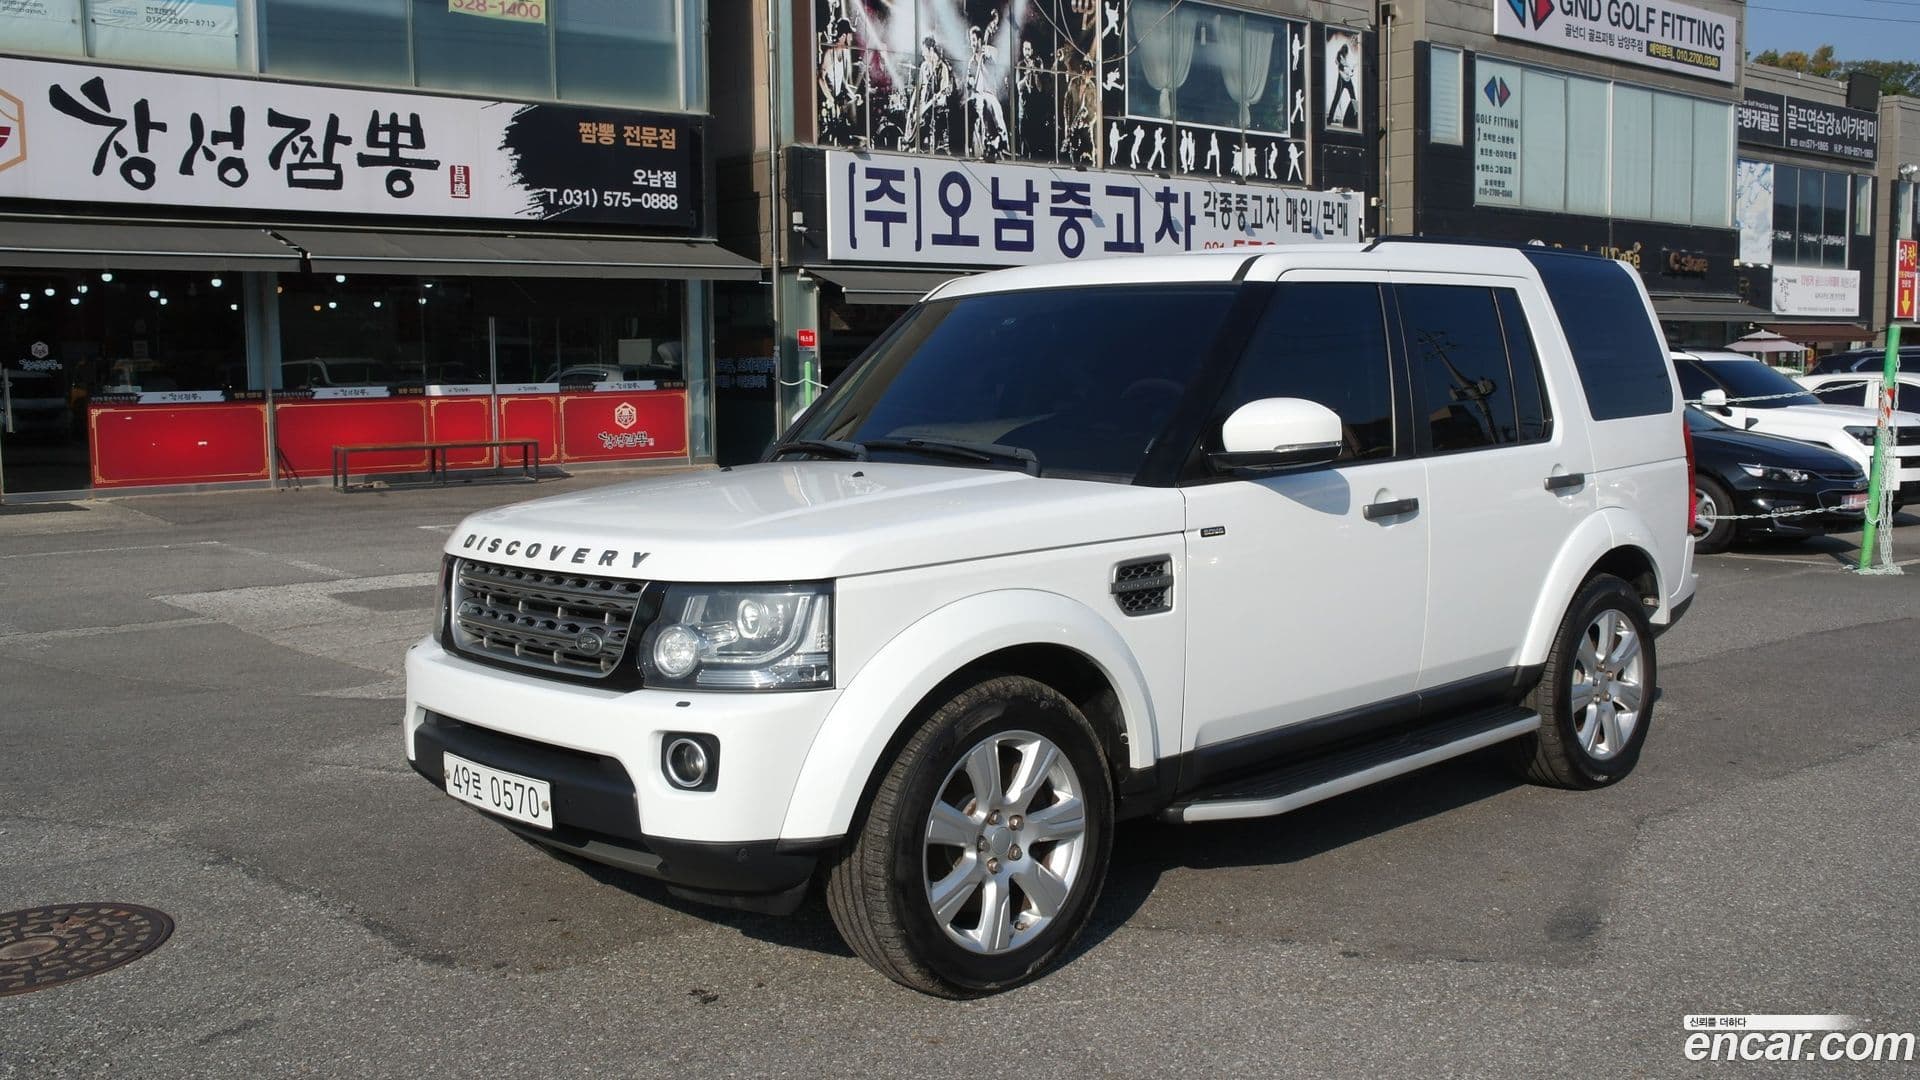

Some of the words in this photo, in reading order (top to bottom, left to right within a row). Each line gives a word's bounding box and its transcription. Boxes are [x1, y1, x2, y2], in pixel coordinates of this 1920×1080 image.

[1560, 0, 1602, 22] GND
[1608, 0, 1656, 34] GOLF
[1662, 11, 1725, 51] FITTING
[1617, 35, 1644, 52] 남양주점
[49, 76, 440, 198] 창성짬뽕
[579, 122, 616, 145] 짬뽕
[623, 126, 676, 150] 전문점
[1494, 116, 1519, 129] FITTING
[1787, 104, 1877, 144] 골프연습장&아카데미
[453, 165, 467, 198] 昌盛
[632, 169, 677, 188] 오남점
[546, 188, 598, 208] T.031)
[603, 191, 678, 210] 575-0888
[849, 162, 1196, 259] (주)오남중고차
[1203, 190, 1279, 233] 각종중고차
[1285, 195, 1349, 237] 매입/판매
[463, 534, 651, 568] DISCOVERY
[453, 764, 483, 800] 49로
[491, 776, 540, 818] 0570
